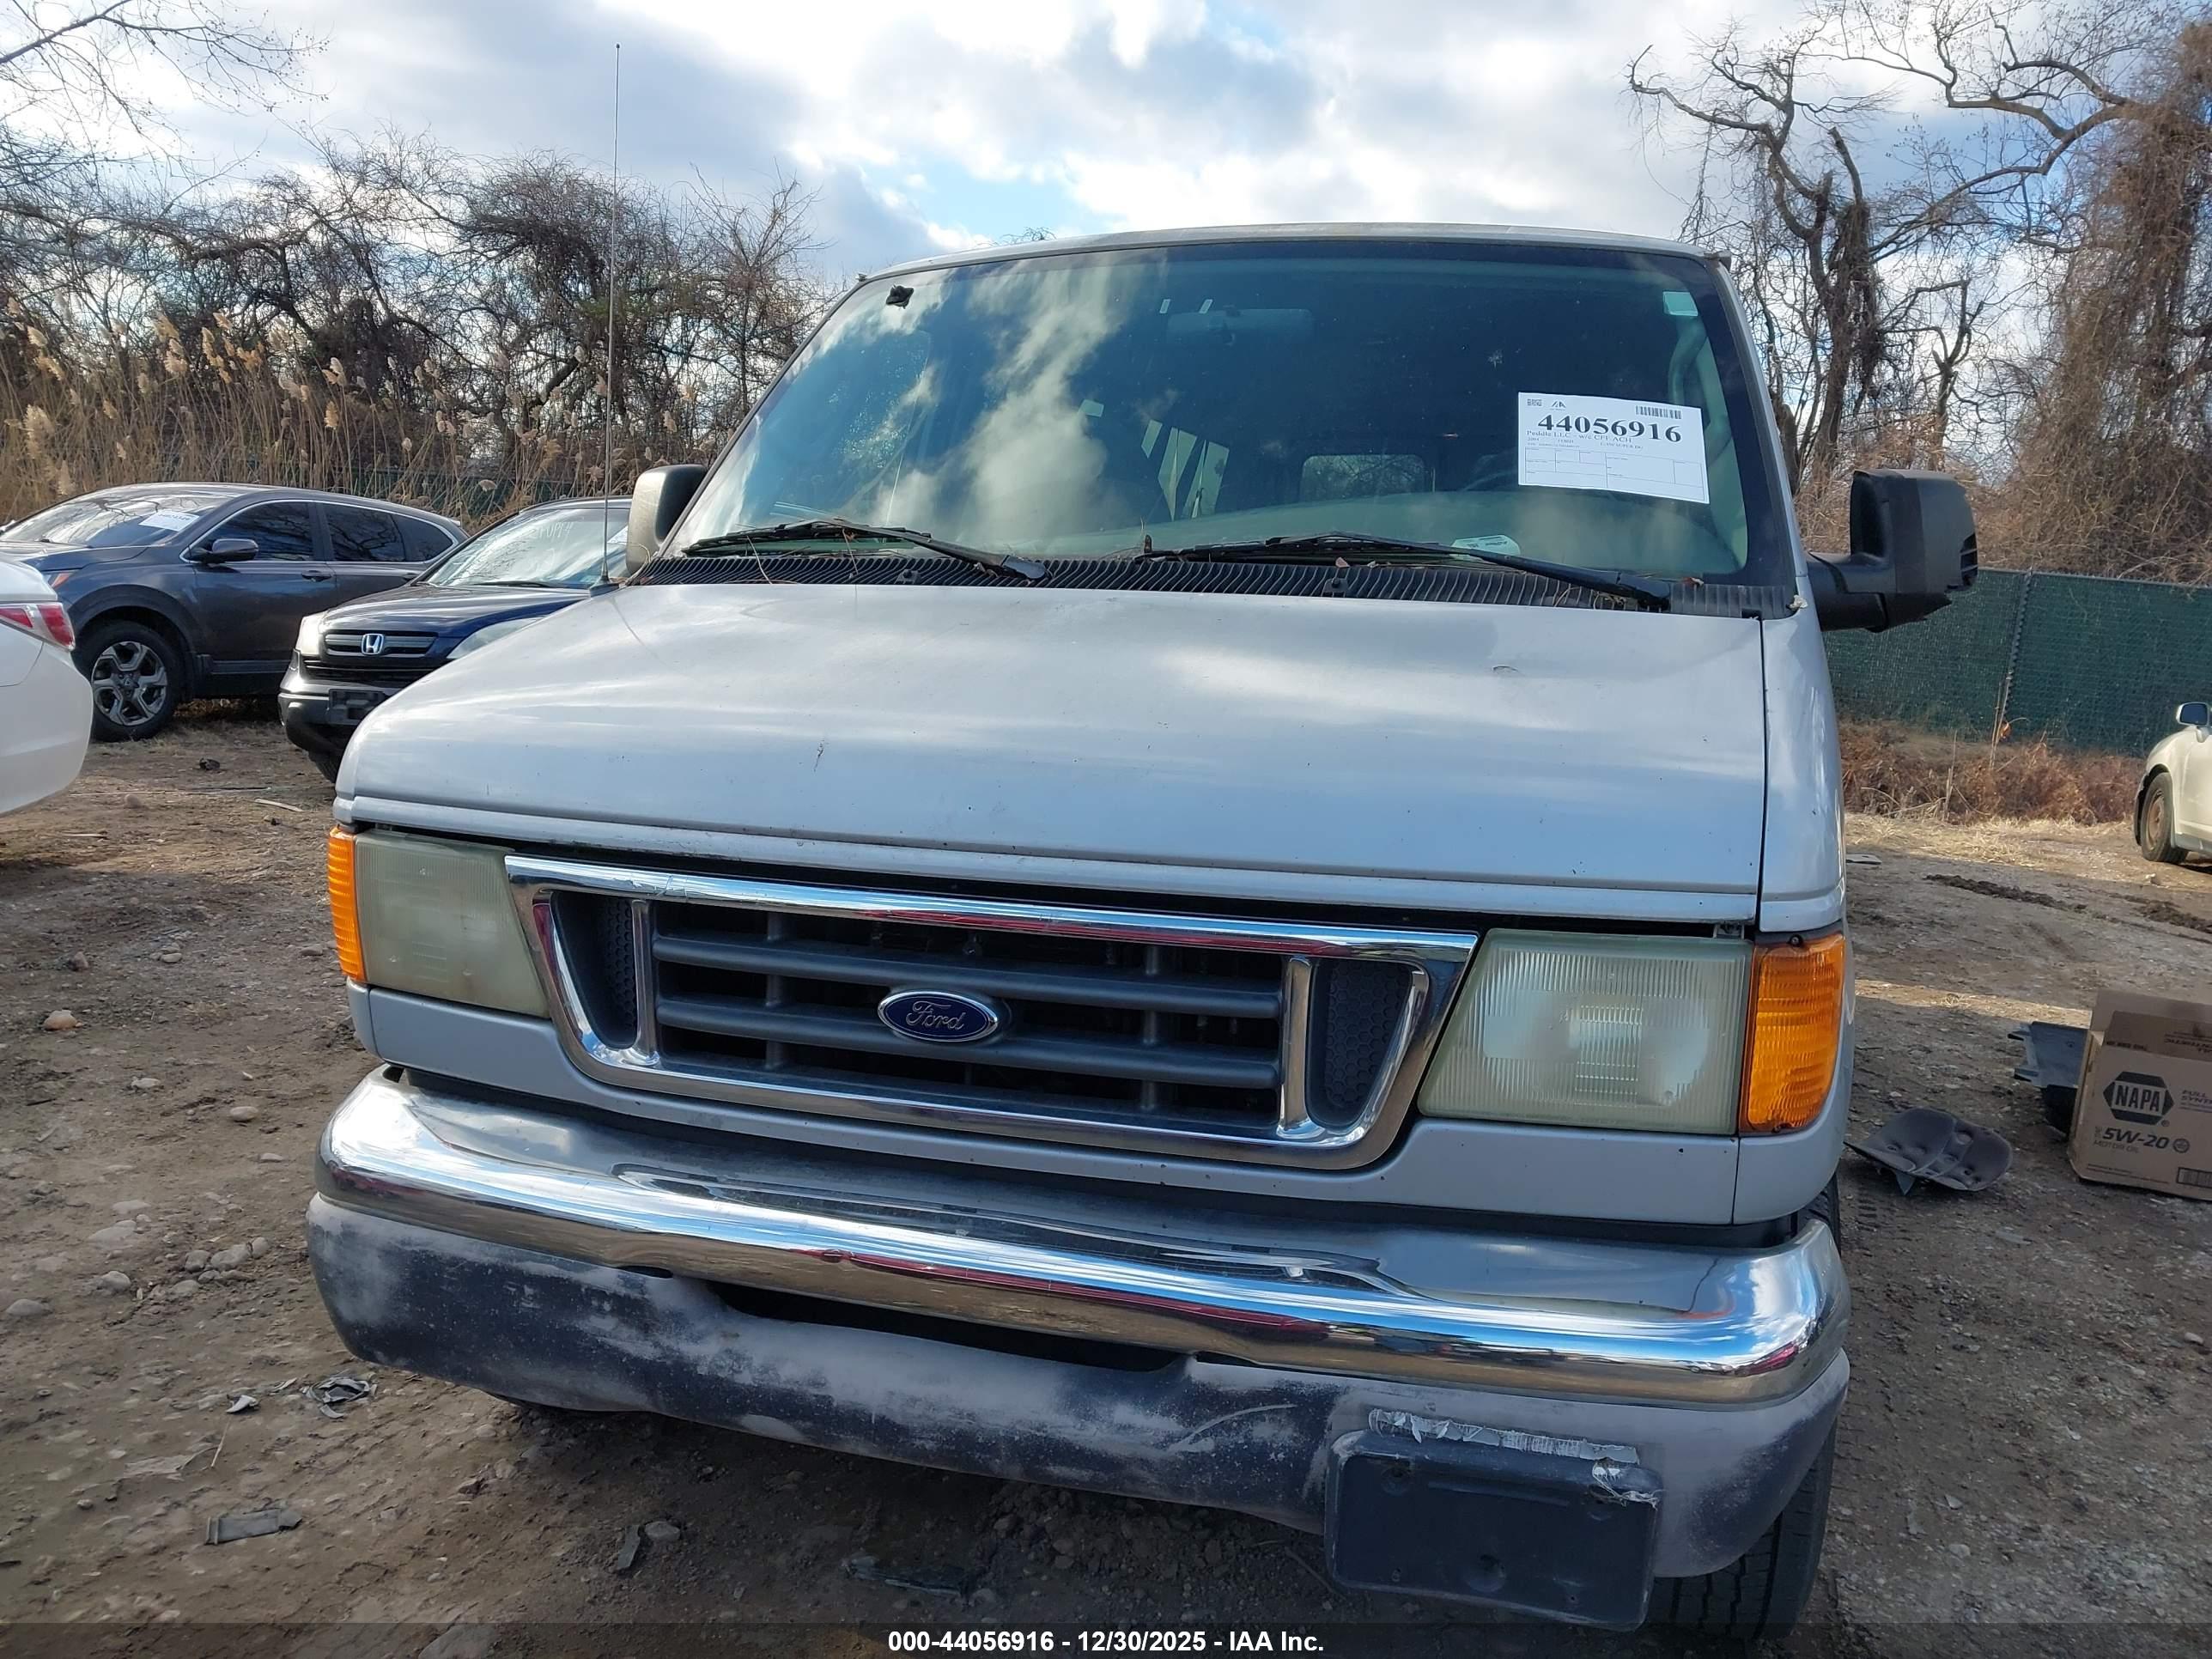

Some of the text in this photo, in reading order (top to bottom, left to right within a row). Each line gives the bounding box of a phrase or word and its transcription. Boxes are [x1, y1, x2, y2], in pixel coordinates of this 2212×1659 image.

[1537, 414, 1682, 443] 44056916
[906, 1000, 967, 1030] Ford
[2115, 1085, 2160, 1112] NAPA
[2102, 1127, 2170, 1149] 5W-20
